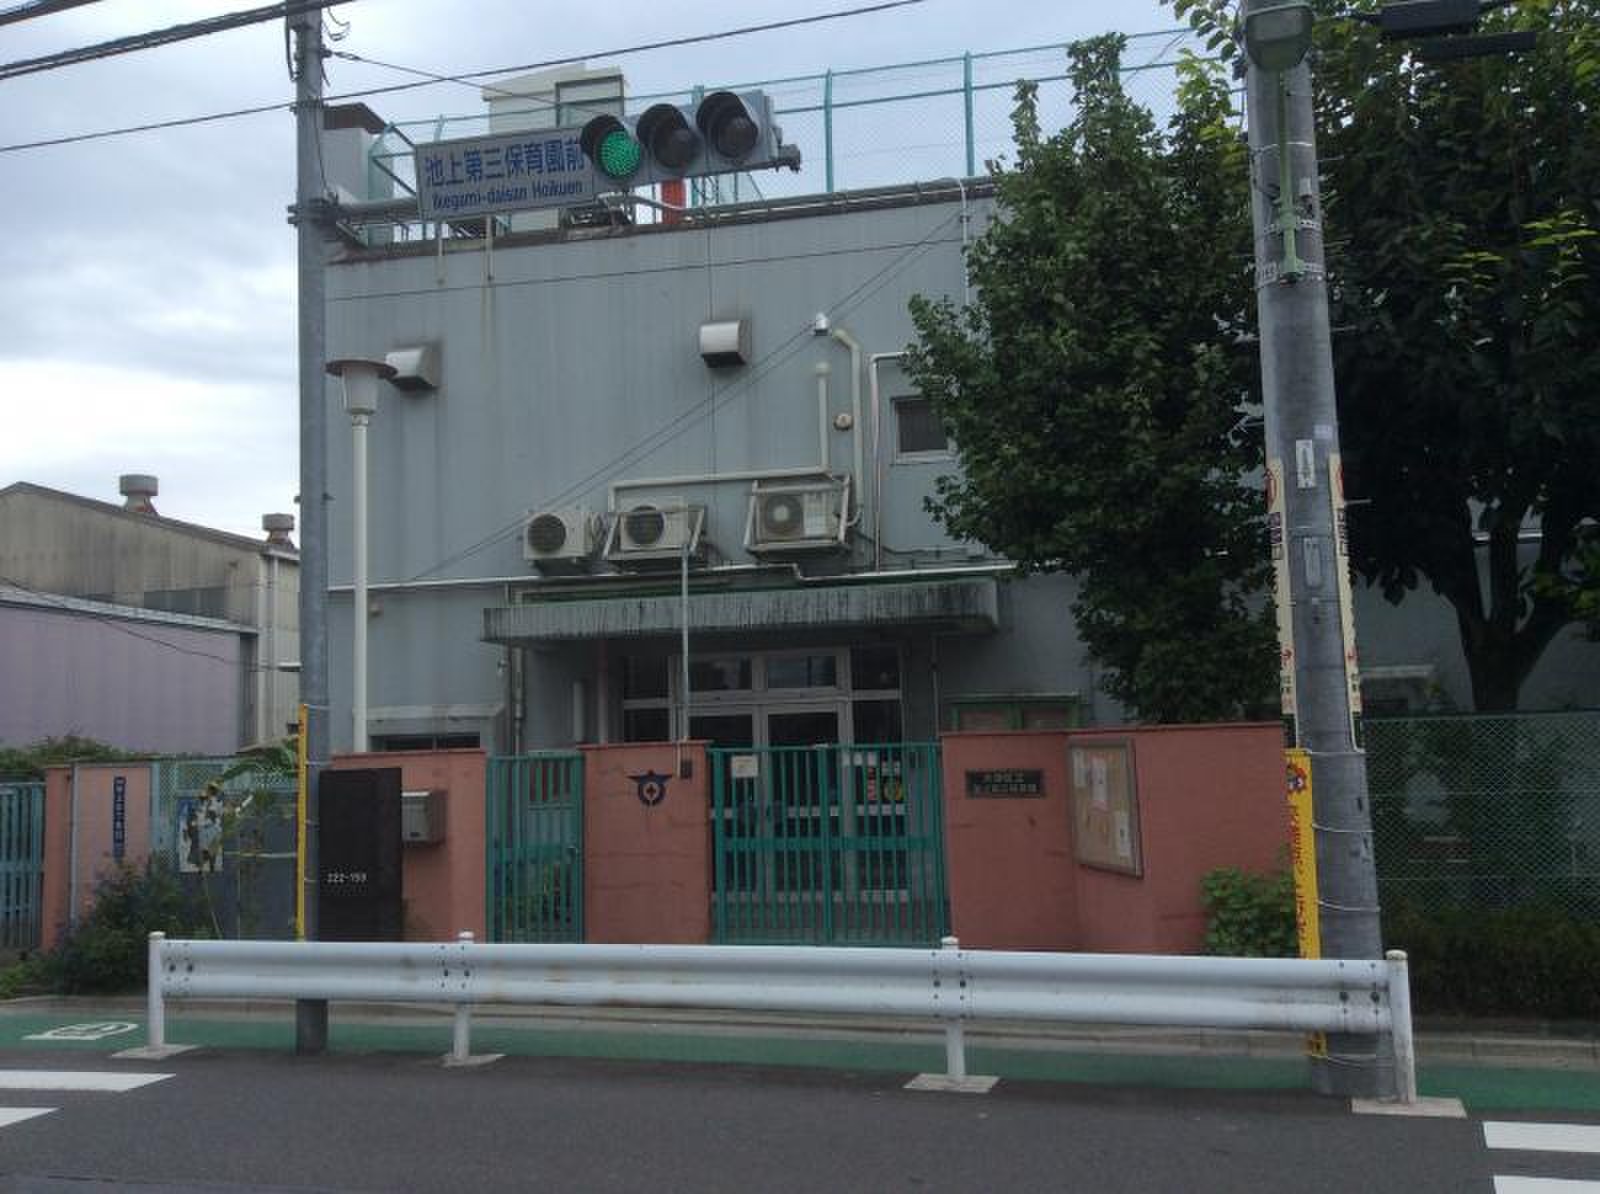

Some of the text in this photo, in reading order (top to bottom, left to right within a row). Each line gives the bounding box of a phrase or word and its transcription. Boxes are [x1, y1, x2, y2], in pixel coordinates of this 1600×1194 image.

[425, 136, 584, 187] 池上第三保育園前
